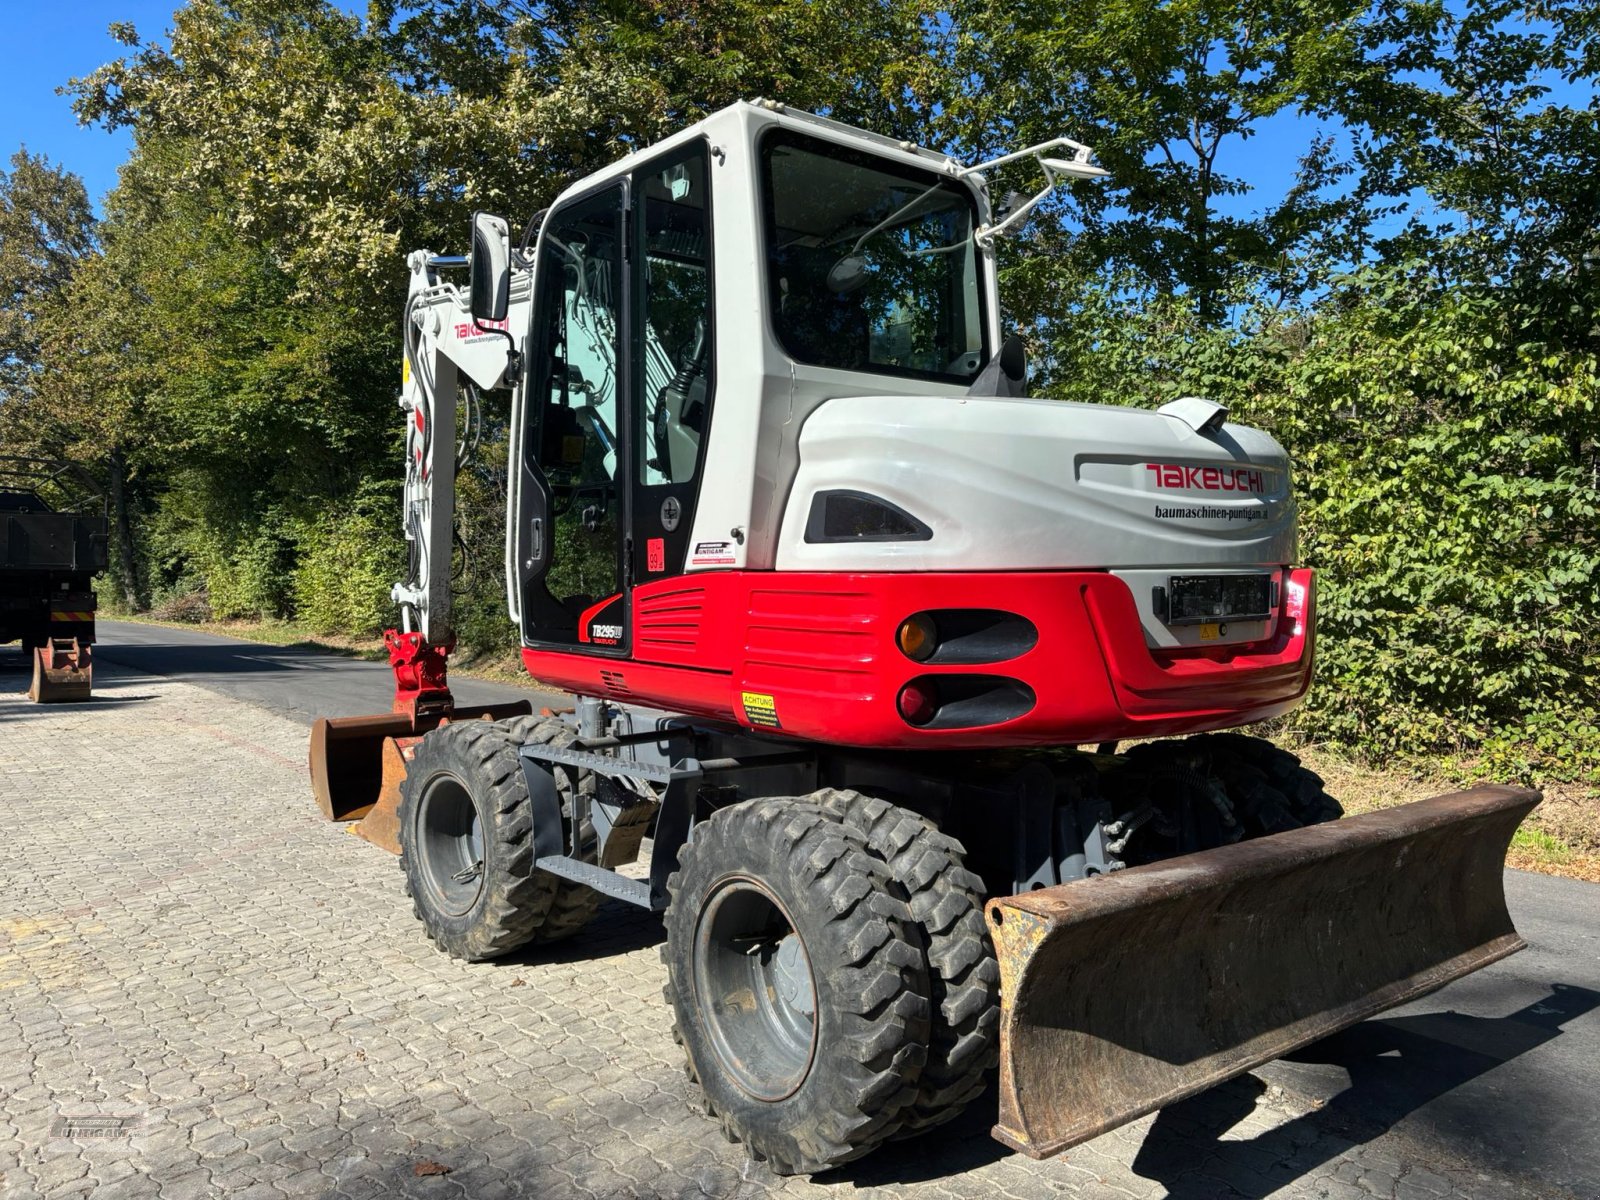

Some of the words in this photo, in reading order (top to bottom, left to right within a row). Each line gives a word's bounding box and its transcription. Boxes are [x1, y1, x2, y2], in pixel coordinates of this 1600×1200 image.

[1146, 464, 1264, 493] TAKEUCHI
[592, 624, 623, 638] TB295W
[744, 696, 773, 707] ACHTUNG
